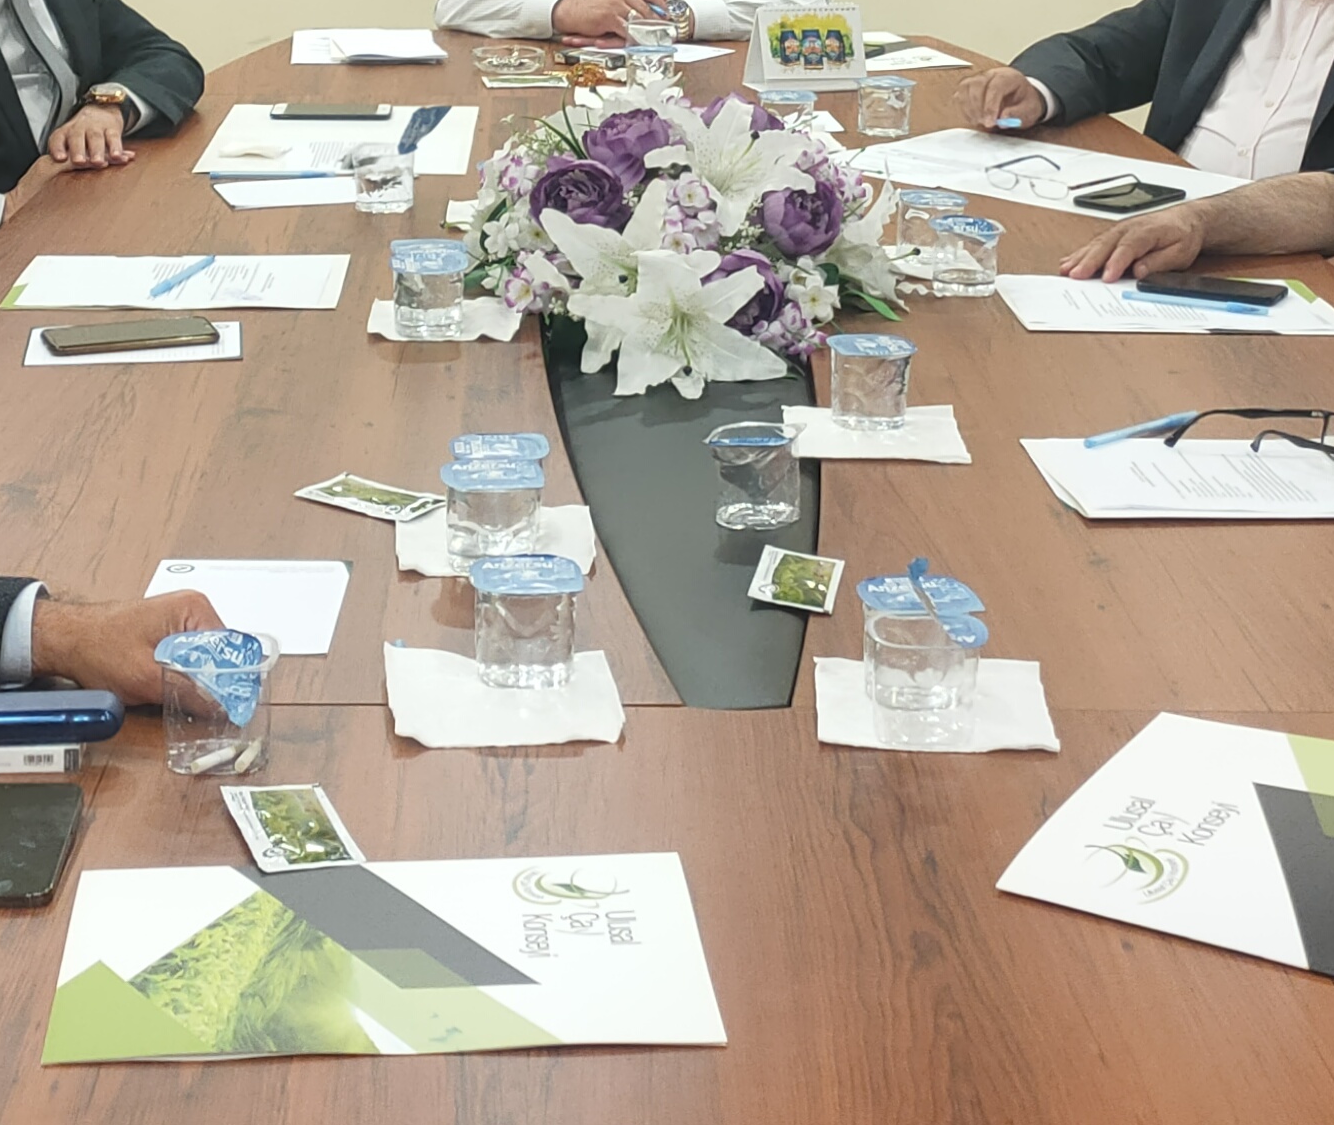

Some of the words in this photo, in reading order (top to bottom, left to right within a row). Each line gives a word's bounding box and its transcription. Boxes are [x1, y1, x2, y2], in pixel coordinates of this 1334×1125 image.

[1103, 795, 1156, 831] Ulusal
[519, 912, 559, 958] Konseyi
[605, 909, 642, 946] Ulusal
